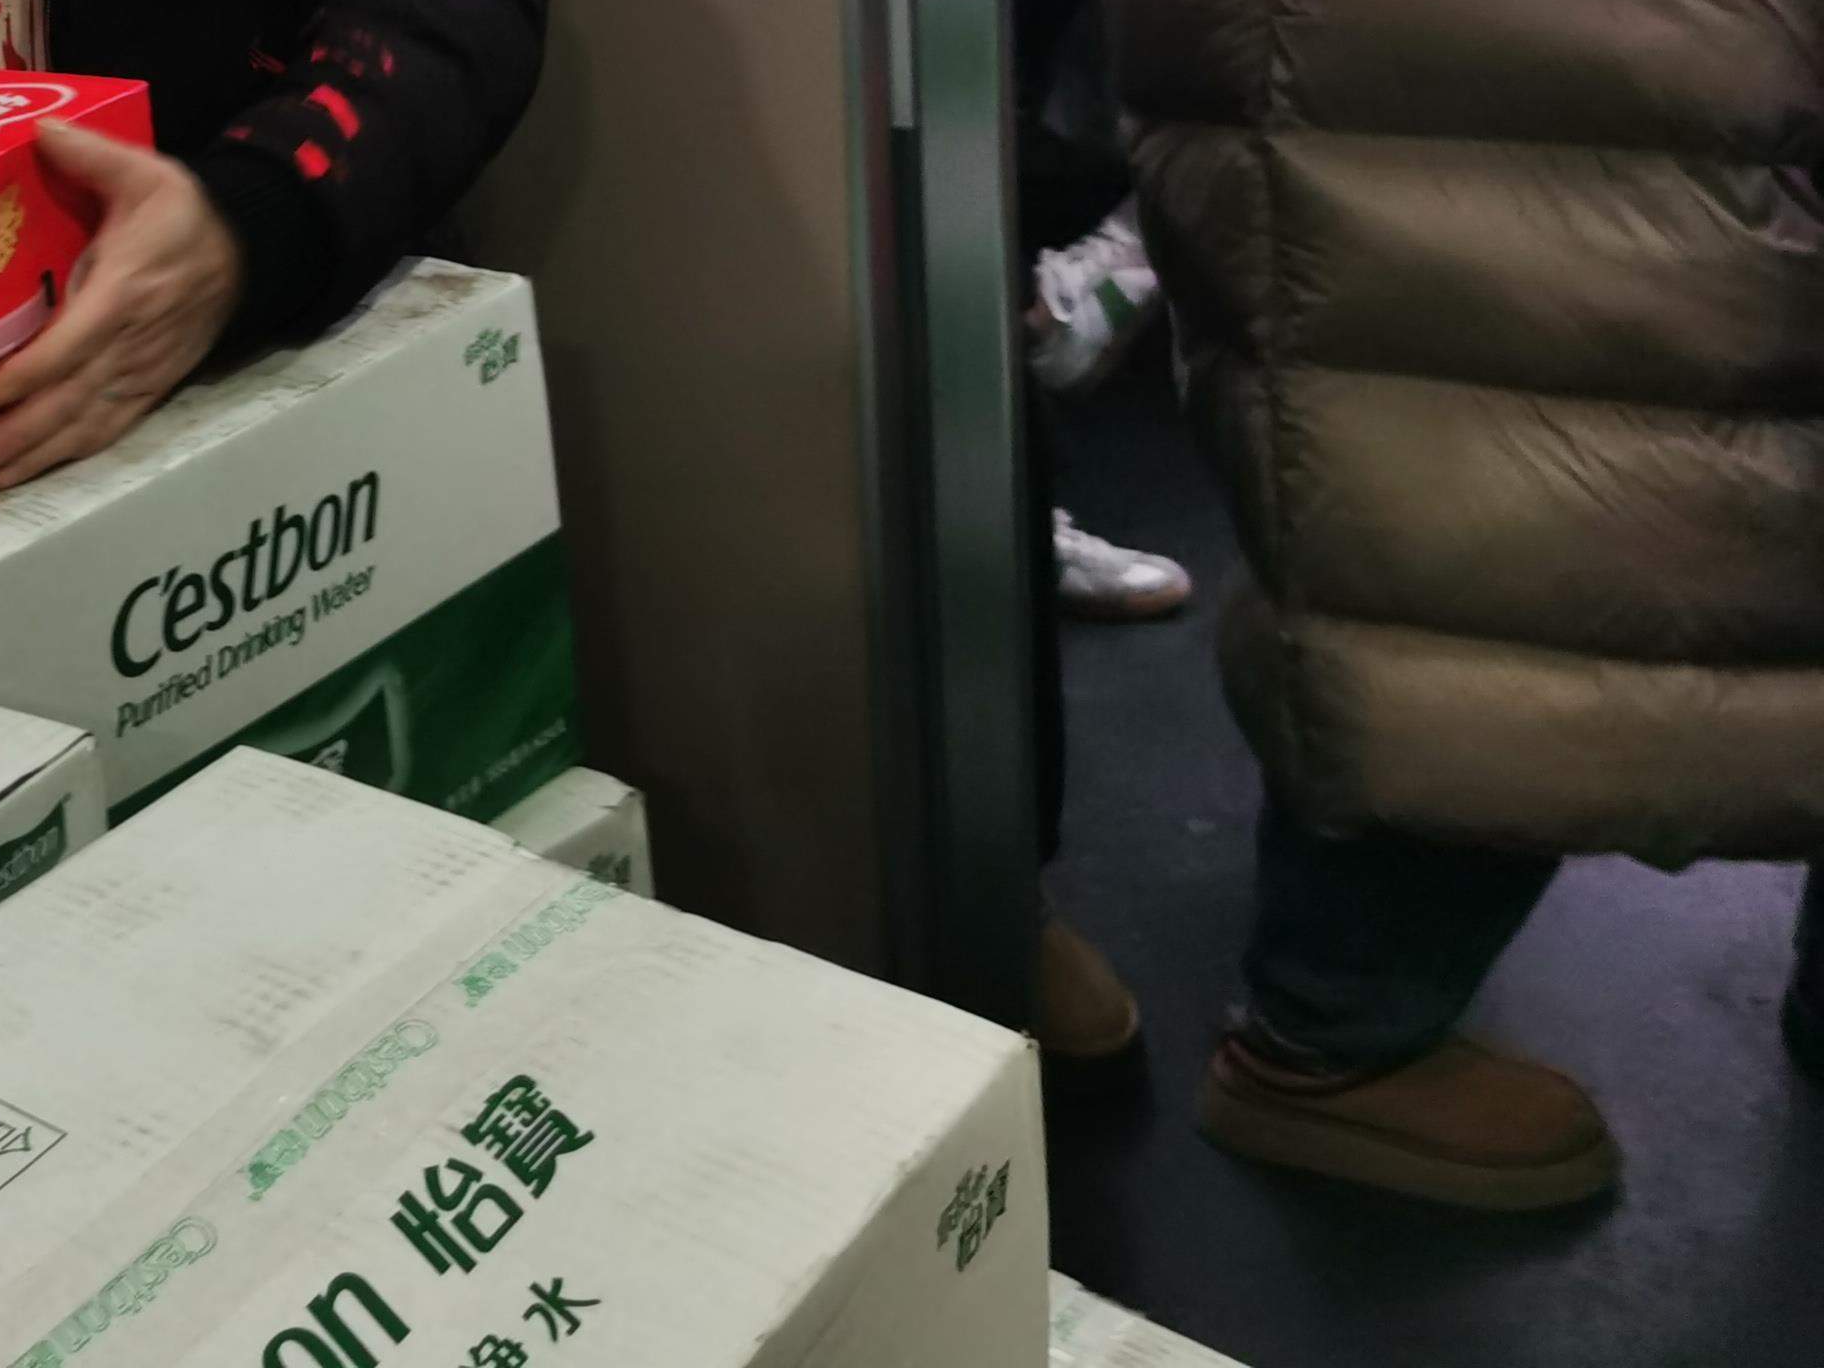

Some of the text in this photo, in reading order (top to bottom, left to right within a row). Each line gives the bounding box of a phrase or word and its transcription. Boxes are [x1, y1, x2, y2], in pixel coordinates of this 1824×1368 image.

[116, 564, 377, 738] Purified Drinking Water
[390, 1074, 595, 1275] 怡寶
